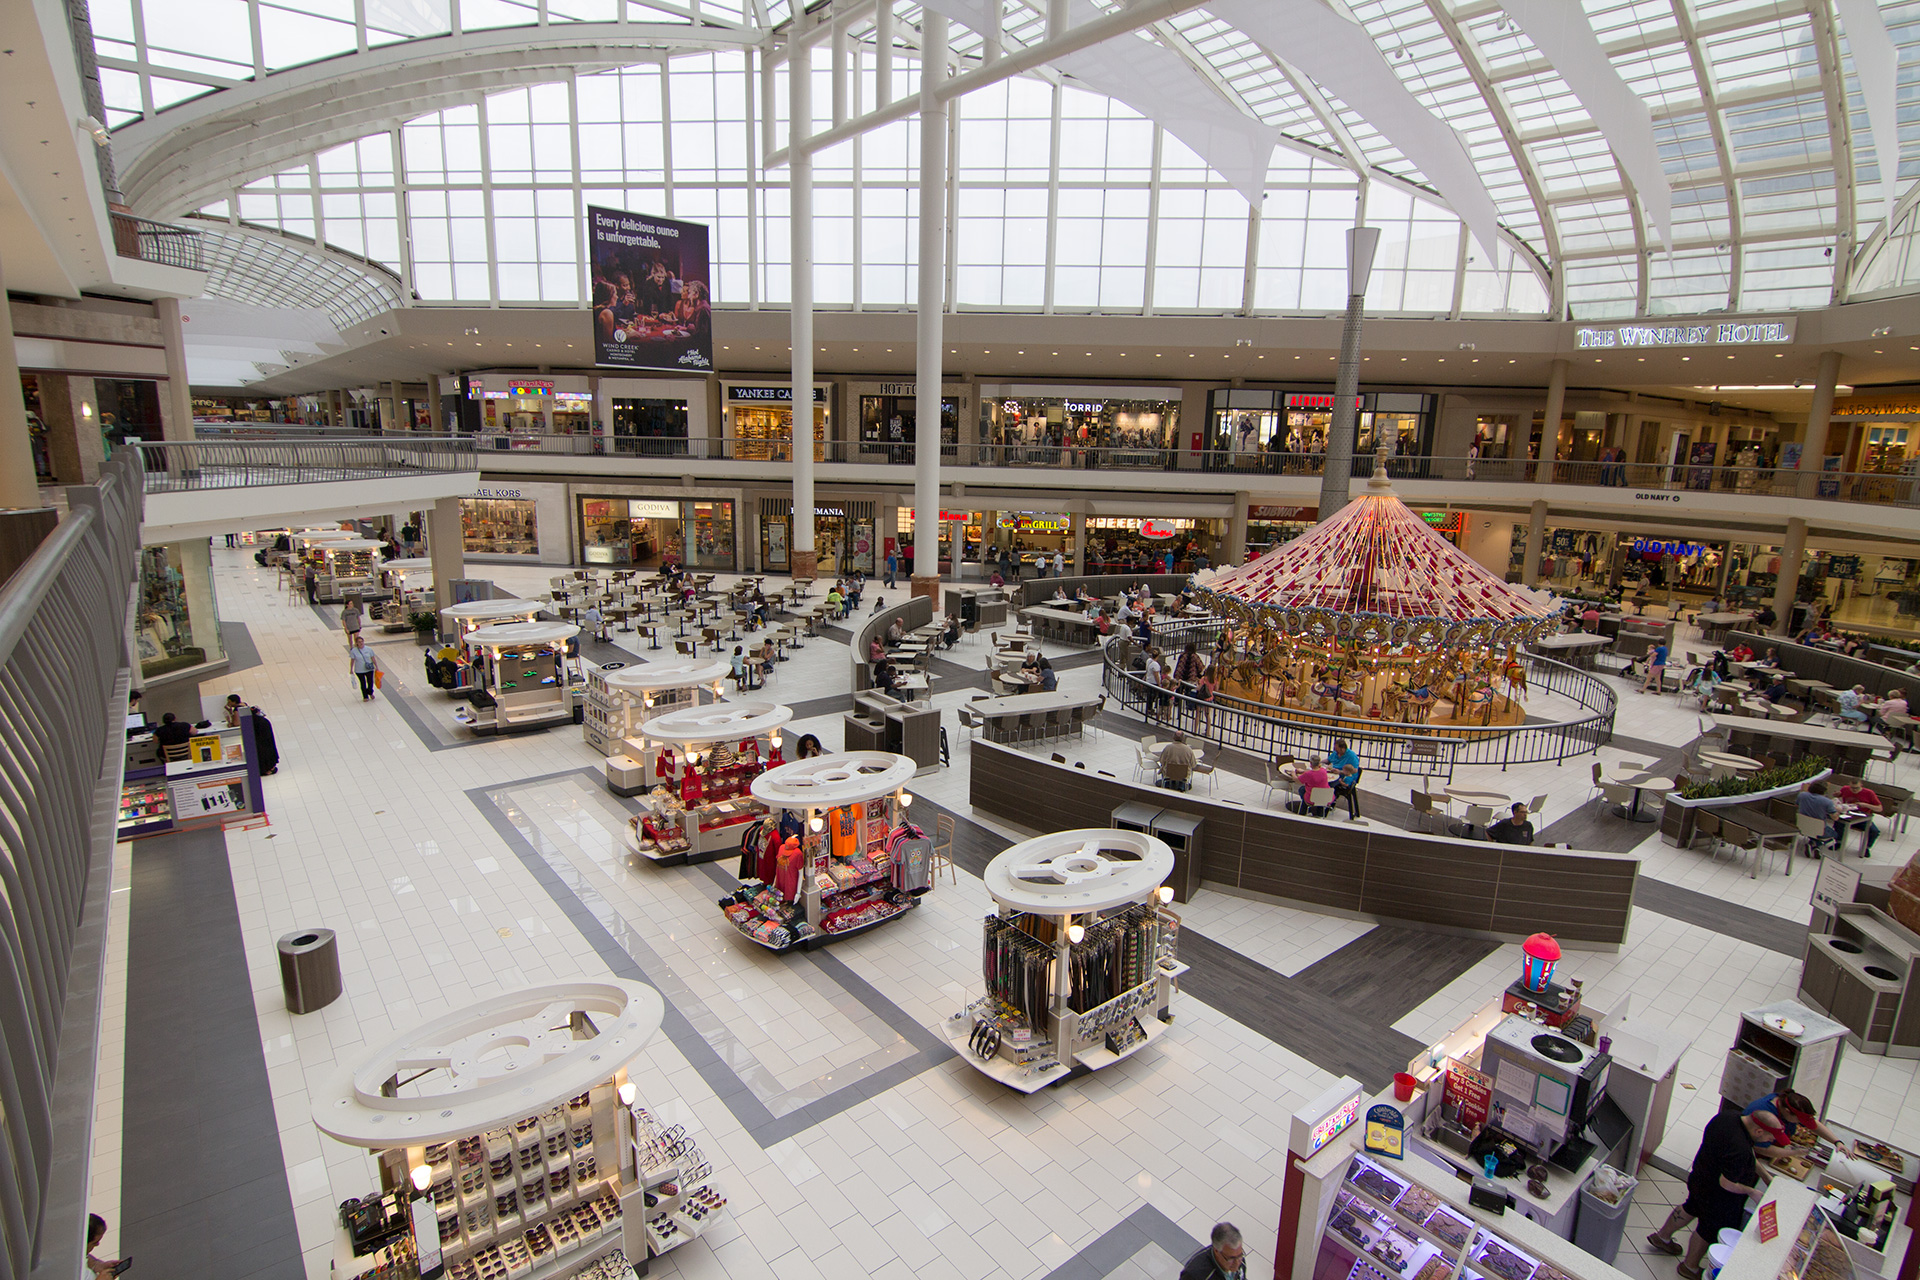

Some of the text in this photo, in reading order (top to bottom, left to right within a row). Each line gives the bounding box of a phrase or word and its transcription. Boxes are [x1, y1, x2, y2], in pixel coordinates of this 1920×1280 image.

[596, 213, 679, 238] Every delicious ounce
[597, 229, 661, 249] is unforgettable.
[1577, 322, 1789, 347] THE WYNFREY HOTEL
[511, 387, 552, 395] COOKIES
[735, 389, 817, 399] YANKEE CAE
[880, 384, 902, 394] HOT
[1064, 402, 1103, 412] TORRID
[1290, 395, 1360, 408] AÉROPOSE
[1831, 403, 1917, 417] ath & Body Works
[496, 489, 521, 497] KORS
[1254, 506, 1303, 517] SUBWAY
[1032, 520, 1059, 529] GRILL
[1633, 540, 1706, 557] OLD NAVY
[1449, 1073, 1460, 1083] Buy
[1466, 1080, 1487, 1096] Cookies
[1453, 1083, 1463, 1092] Get
[1469, 1089, 1481, 1101] Free
[1446, 1090, 1456, 1099] Buy
[1465, 1099, 1485, 1114] Cookies
[1466, 1107, 1478, 1118] Free
[1313, 1111, 1356, 1149] COOKIES
